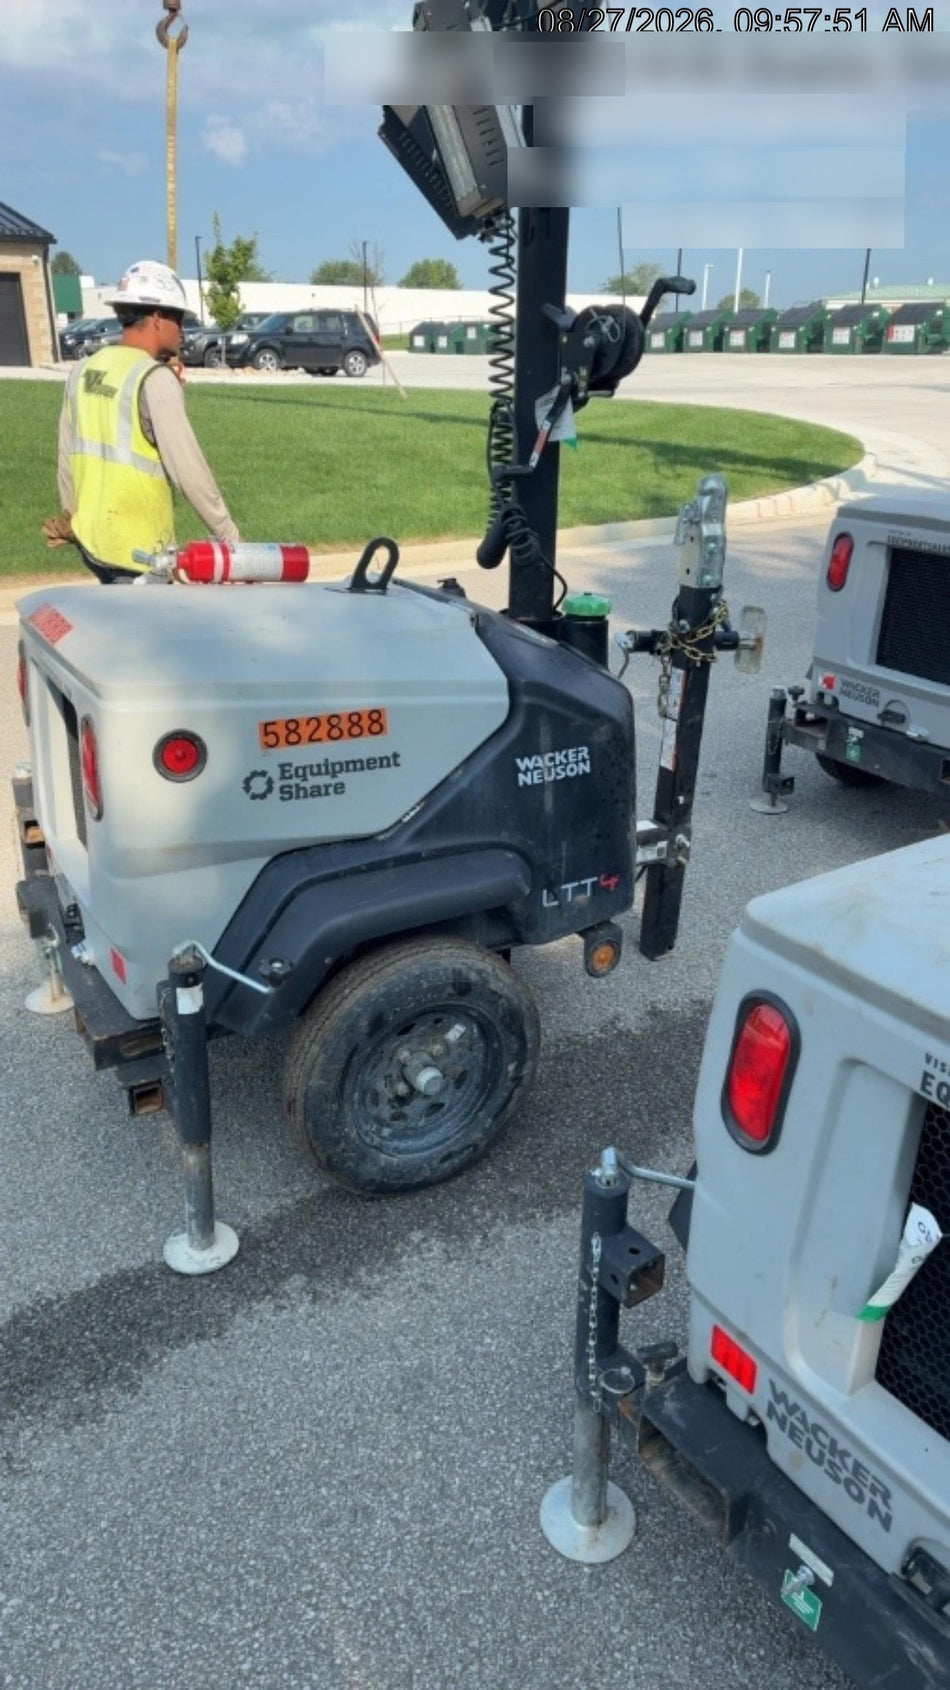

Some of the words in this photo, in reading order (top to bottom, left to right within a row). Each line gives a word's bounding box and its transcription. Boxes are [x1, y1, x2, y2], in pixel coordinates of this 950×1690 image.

[263, 709, 384, 748] 582888
[278, 751, 401, 782] Equipment
[515, 747, 590, 772] WACKER
[517, 760, 591, 787] NEUSON
[278, 781, 346, 802] Share
[542, 874, 620, 908] LTT4
[768, 1378, 893, 1510] WACKER
[766, 1400, 893, 1533] NEUSON
